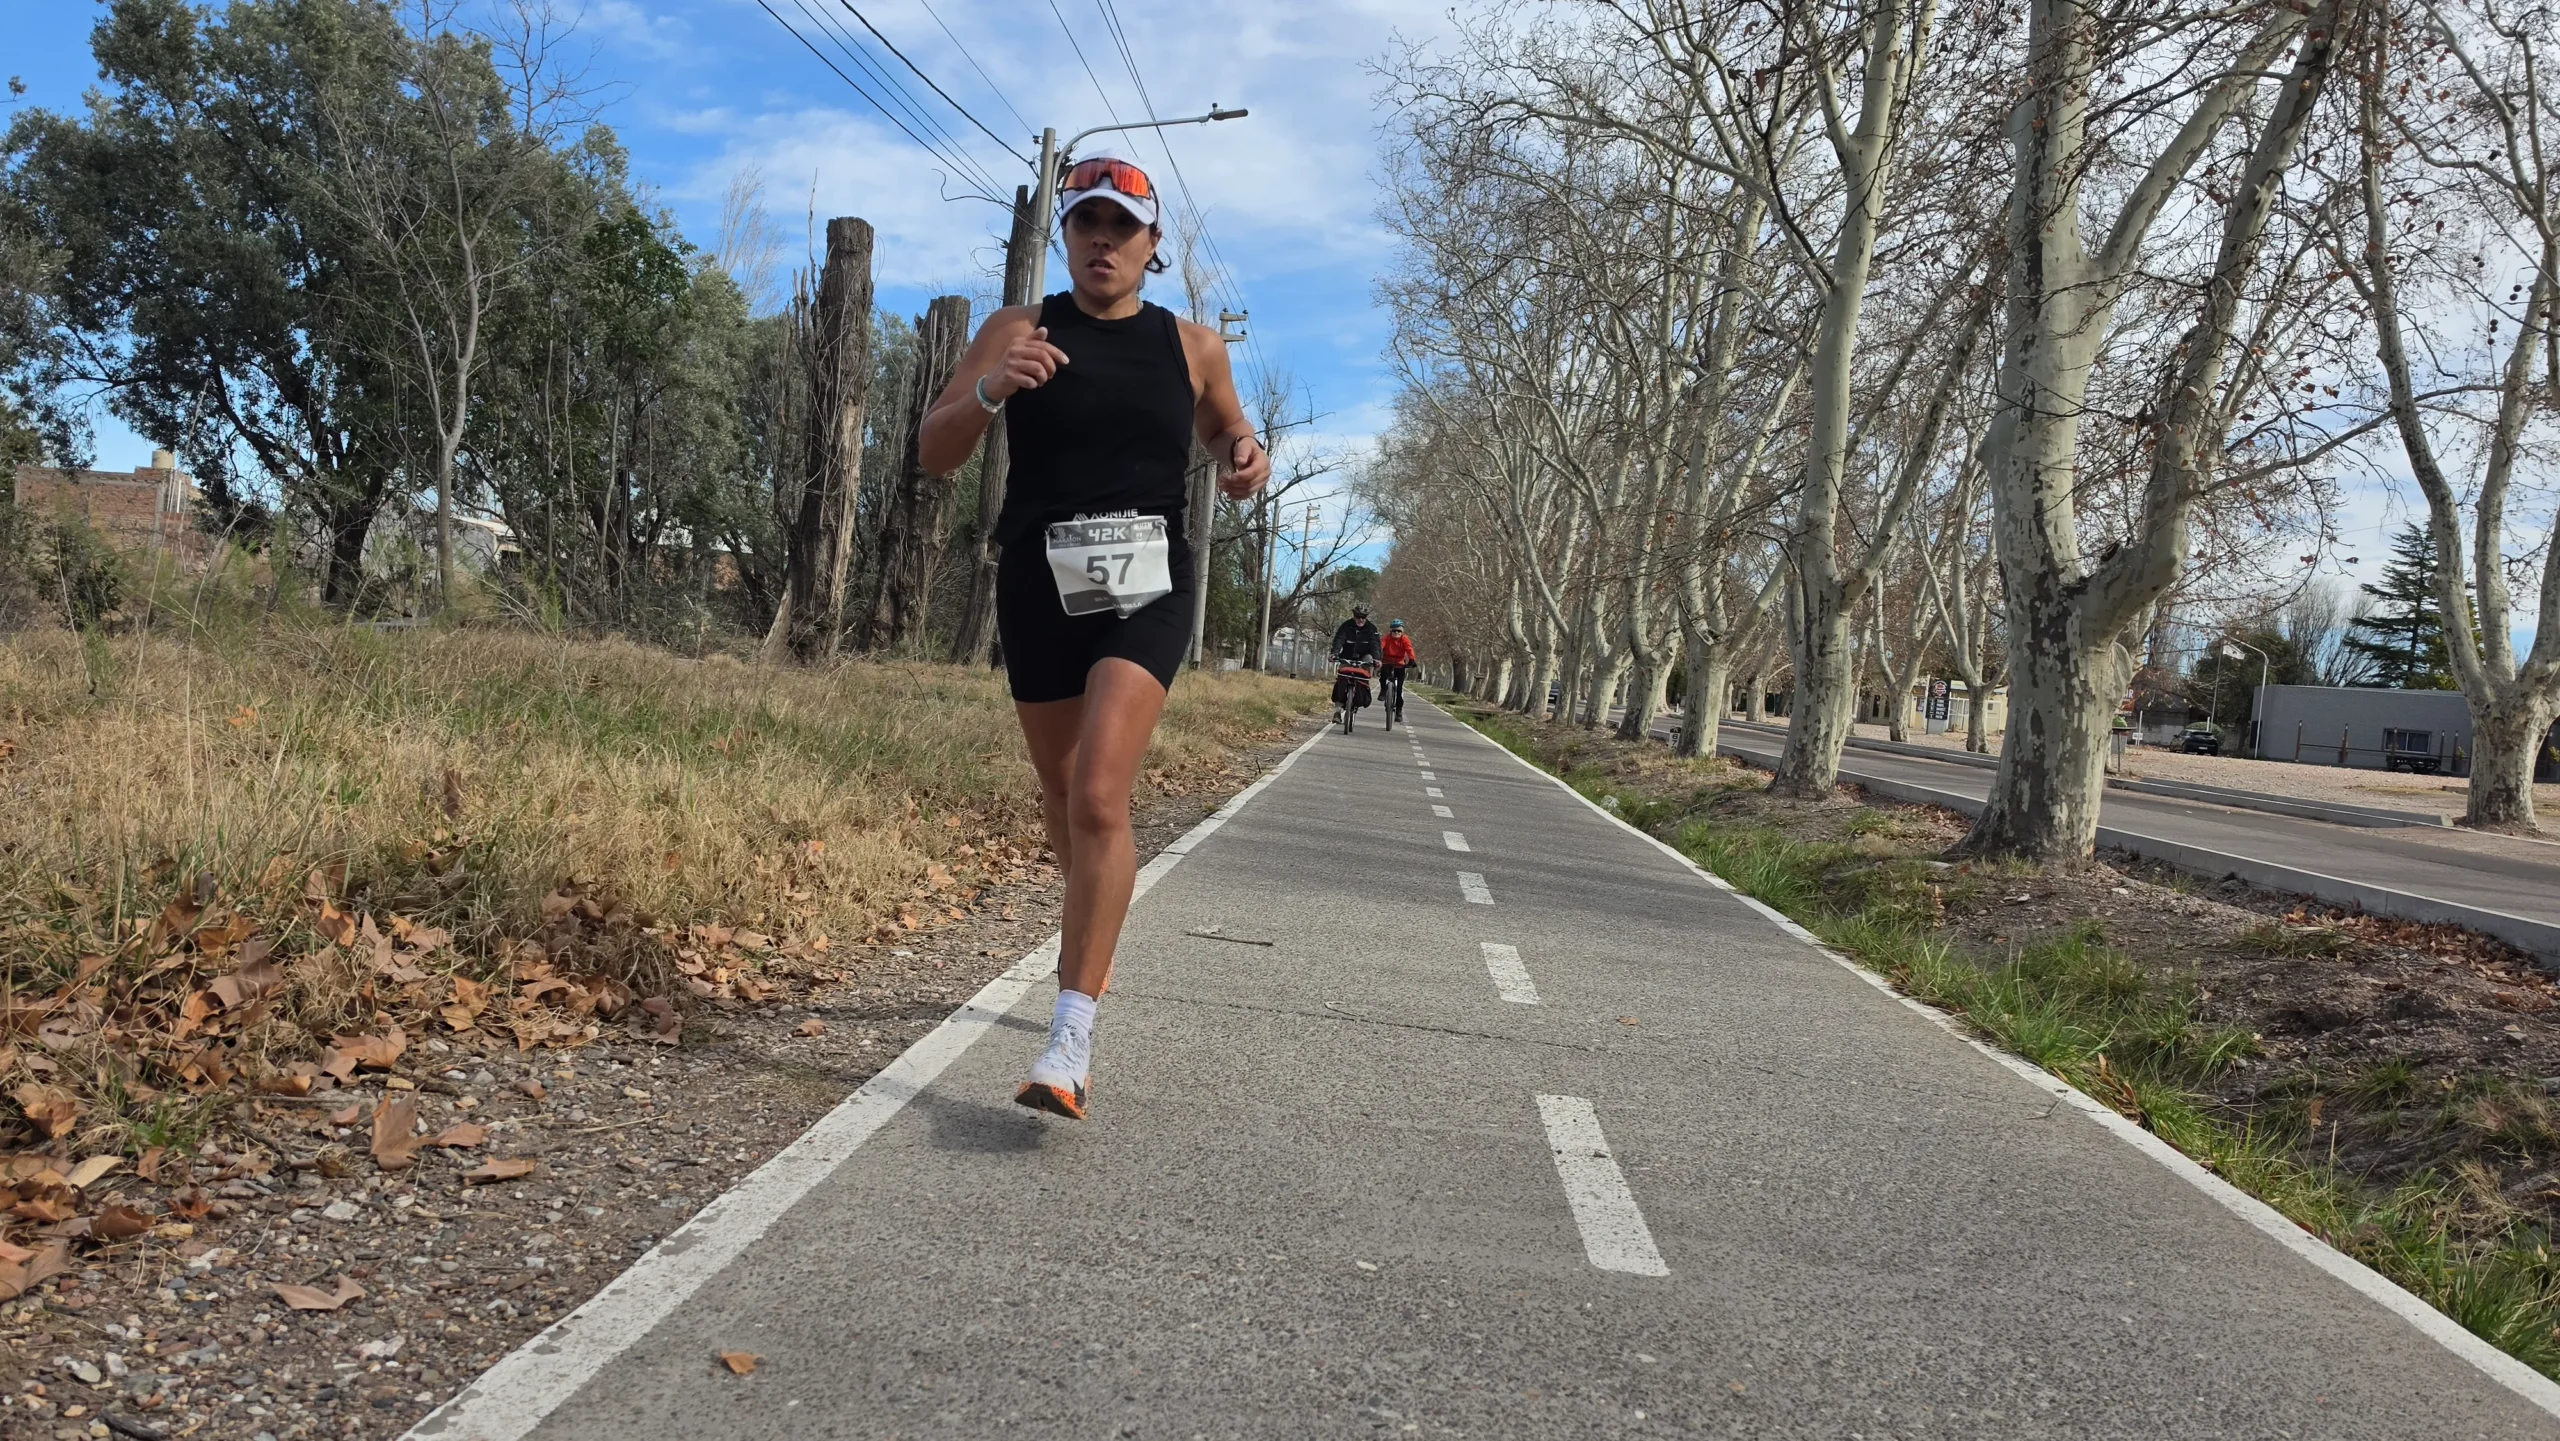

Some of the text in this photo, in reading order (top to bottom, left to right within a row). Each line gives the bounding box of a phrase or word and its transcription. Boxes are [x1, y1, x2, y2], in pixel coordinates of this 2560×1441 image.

[1090, 508, 1139, 520] AONIJIE
[1088, 527, 1127, 541] 42K
[1086, 552, 1134, 585] 57
